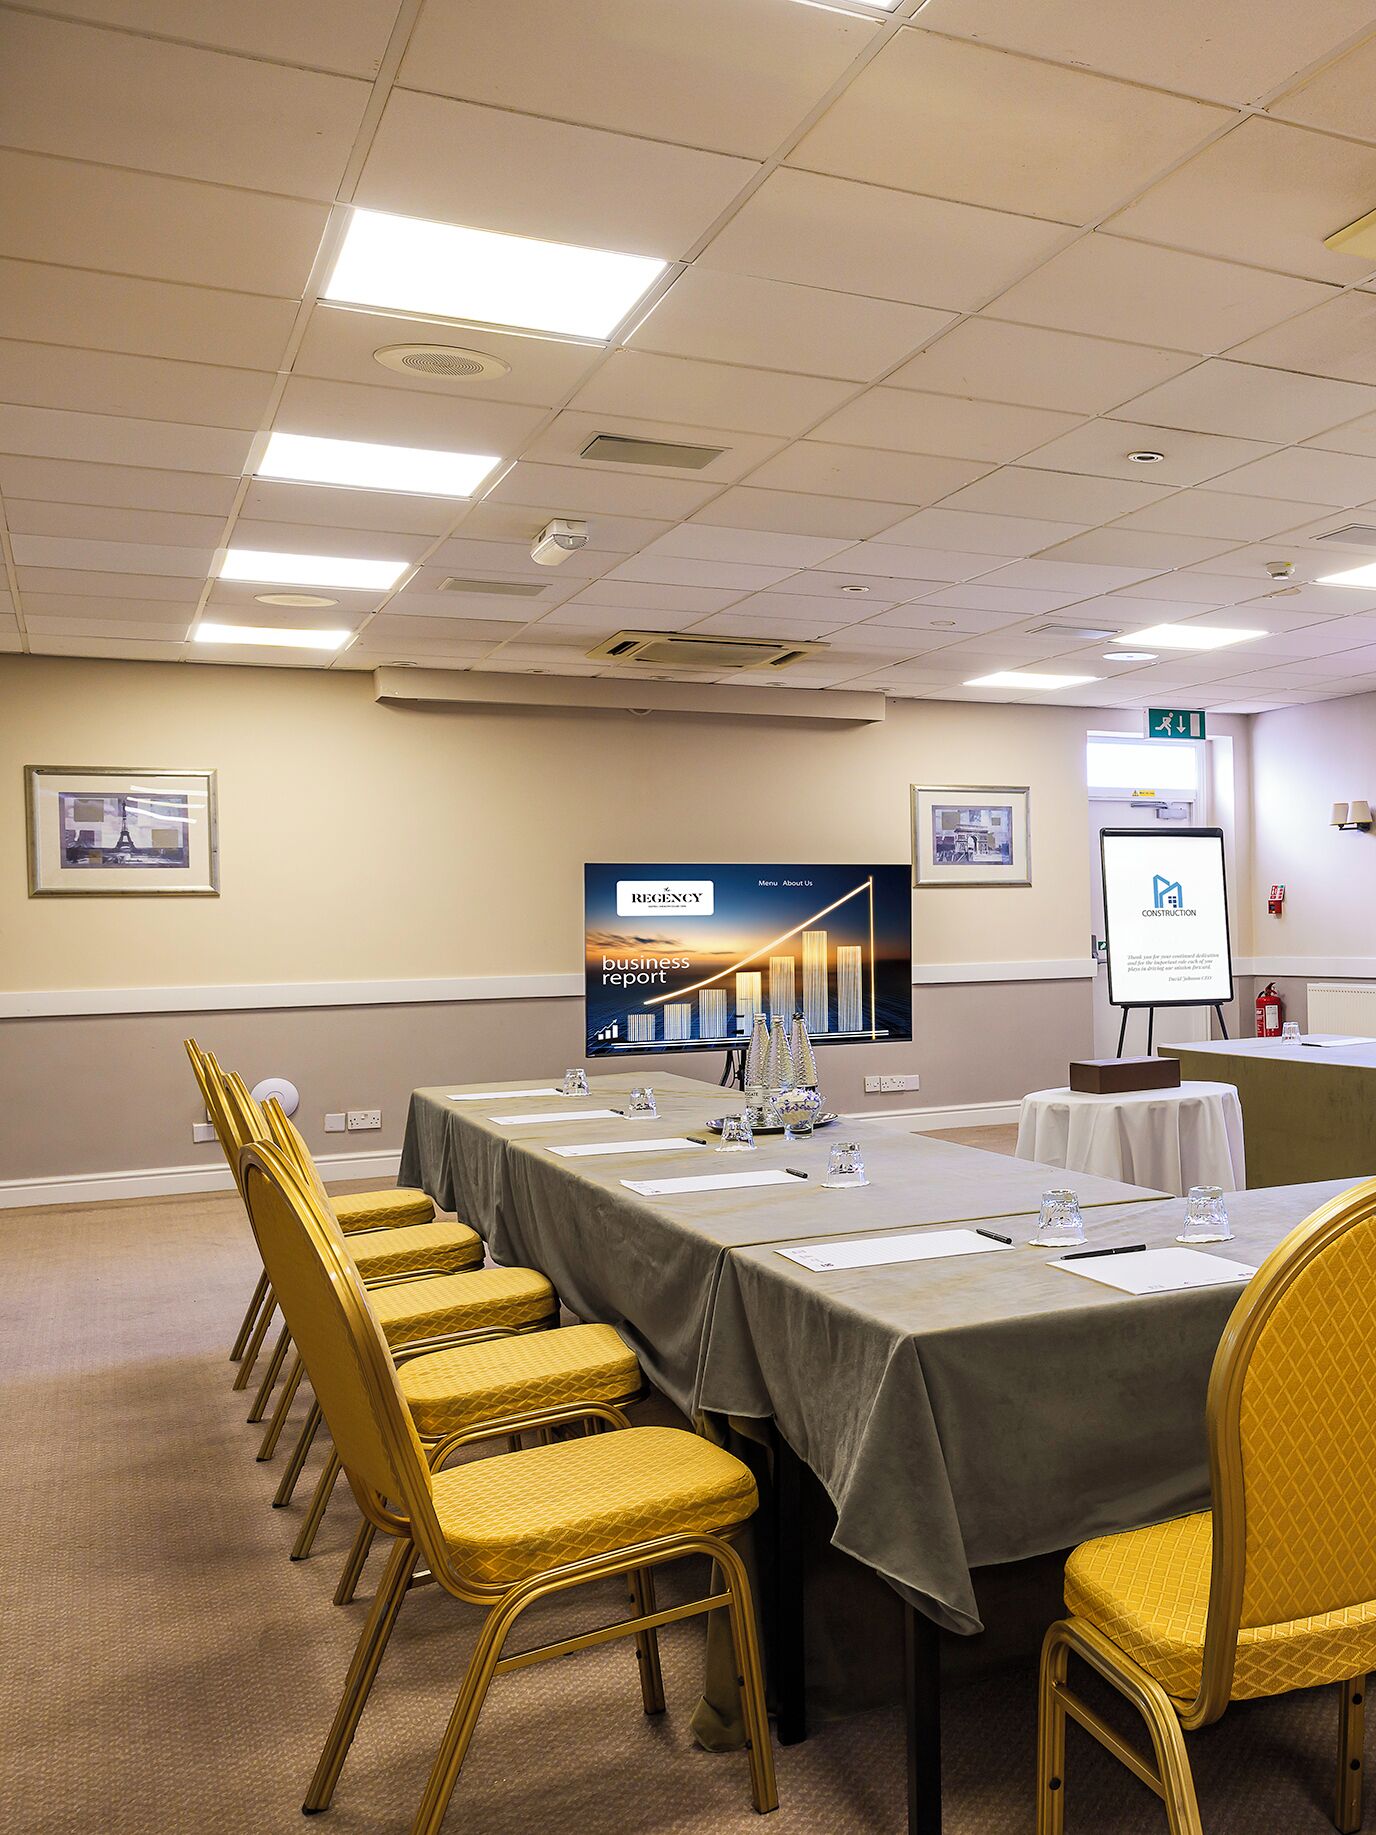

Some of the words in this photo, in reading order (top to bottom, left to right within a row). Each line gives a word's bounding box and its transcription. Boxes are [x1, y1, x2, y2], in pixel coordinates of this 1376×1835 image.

[631, 892, 704, 903] REGENCY
[1142, 909, 1197, 917] CONSTRUCTION
[602, 955, 690, 971] business
[602, 969, 667, 988] report
